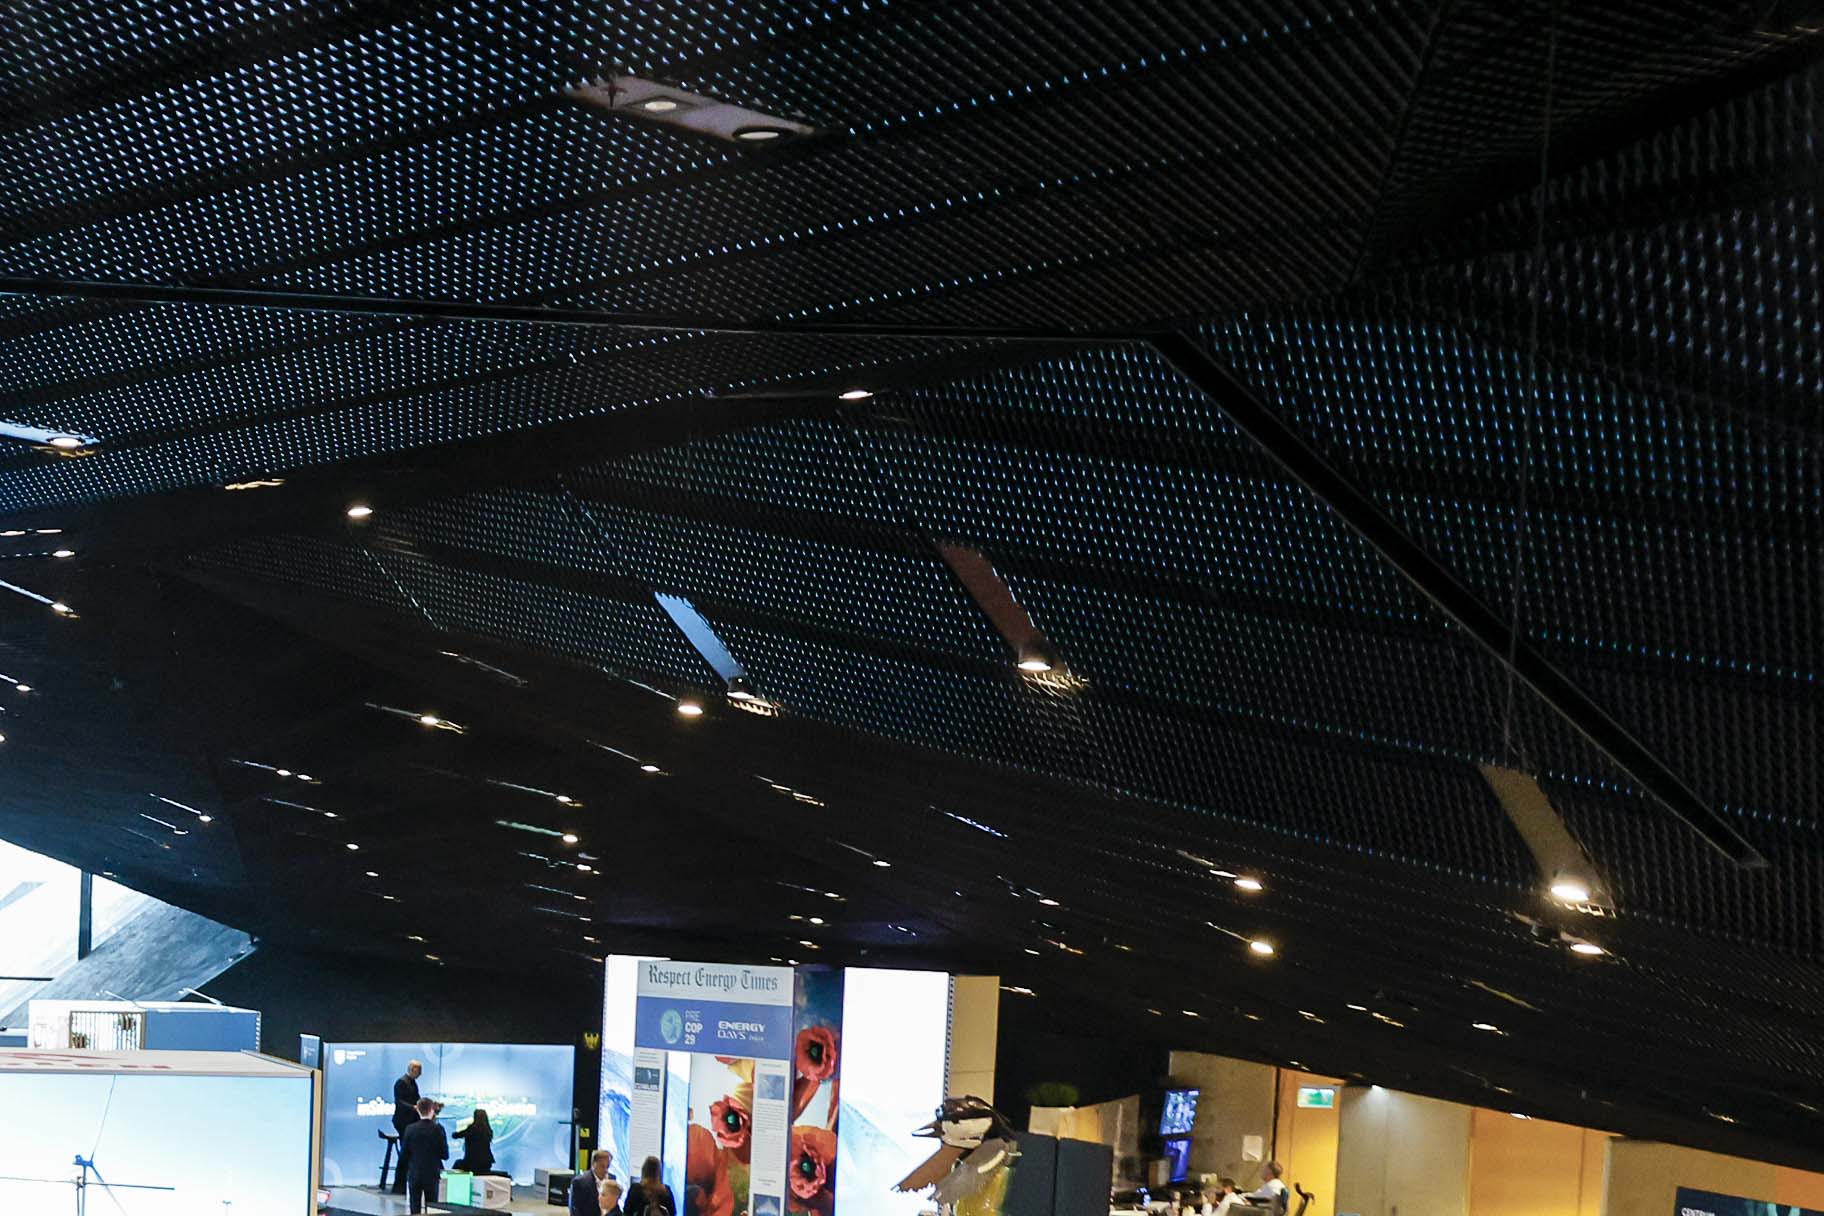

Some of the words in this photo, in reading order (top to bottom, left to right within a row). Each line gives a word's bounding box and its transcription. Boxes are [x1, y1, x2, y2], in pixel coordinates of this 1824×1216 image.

[649, 965, 691, 987] Respect
[695, 968, 737, 992] Energy
[741, 970, 778, 991] Times
[684, 1022, 703, 1034] COP
[718, 1020, 766, 1033] ENERGY
[684, 1034, 696, 1045] 29
